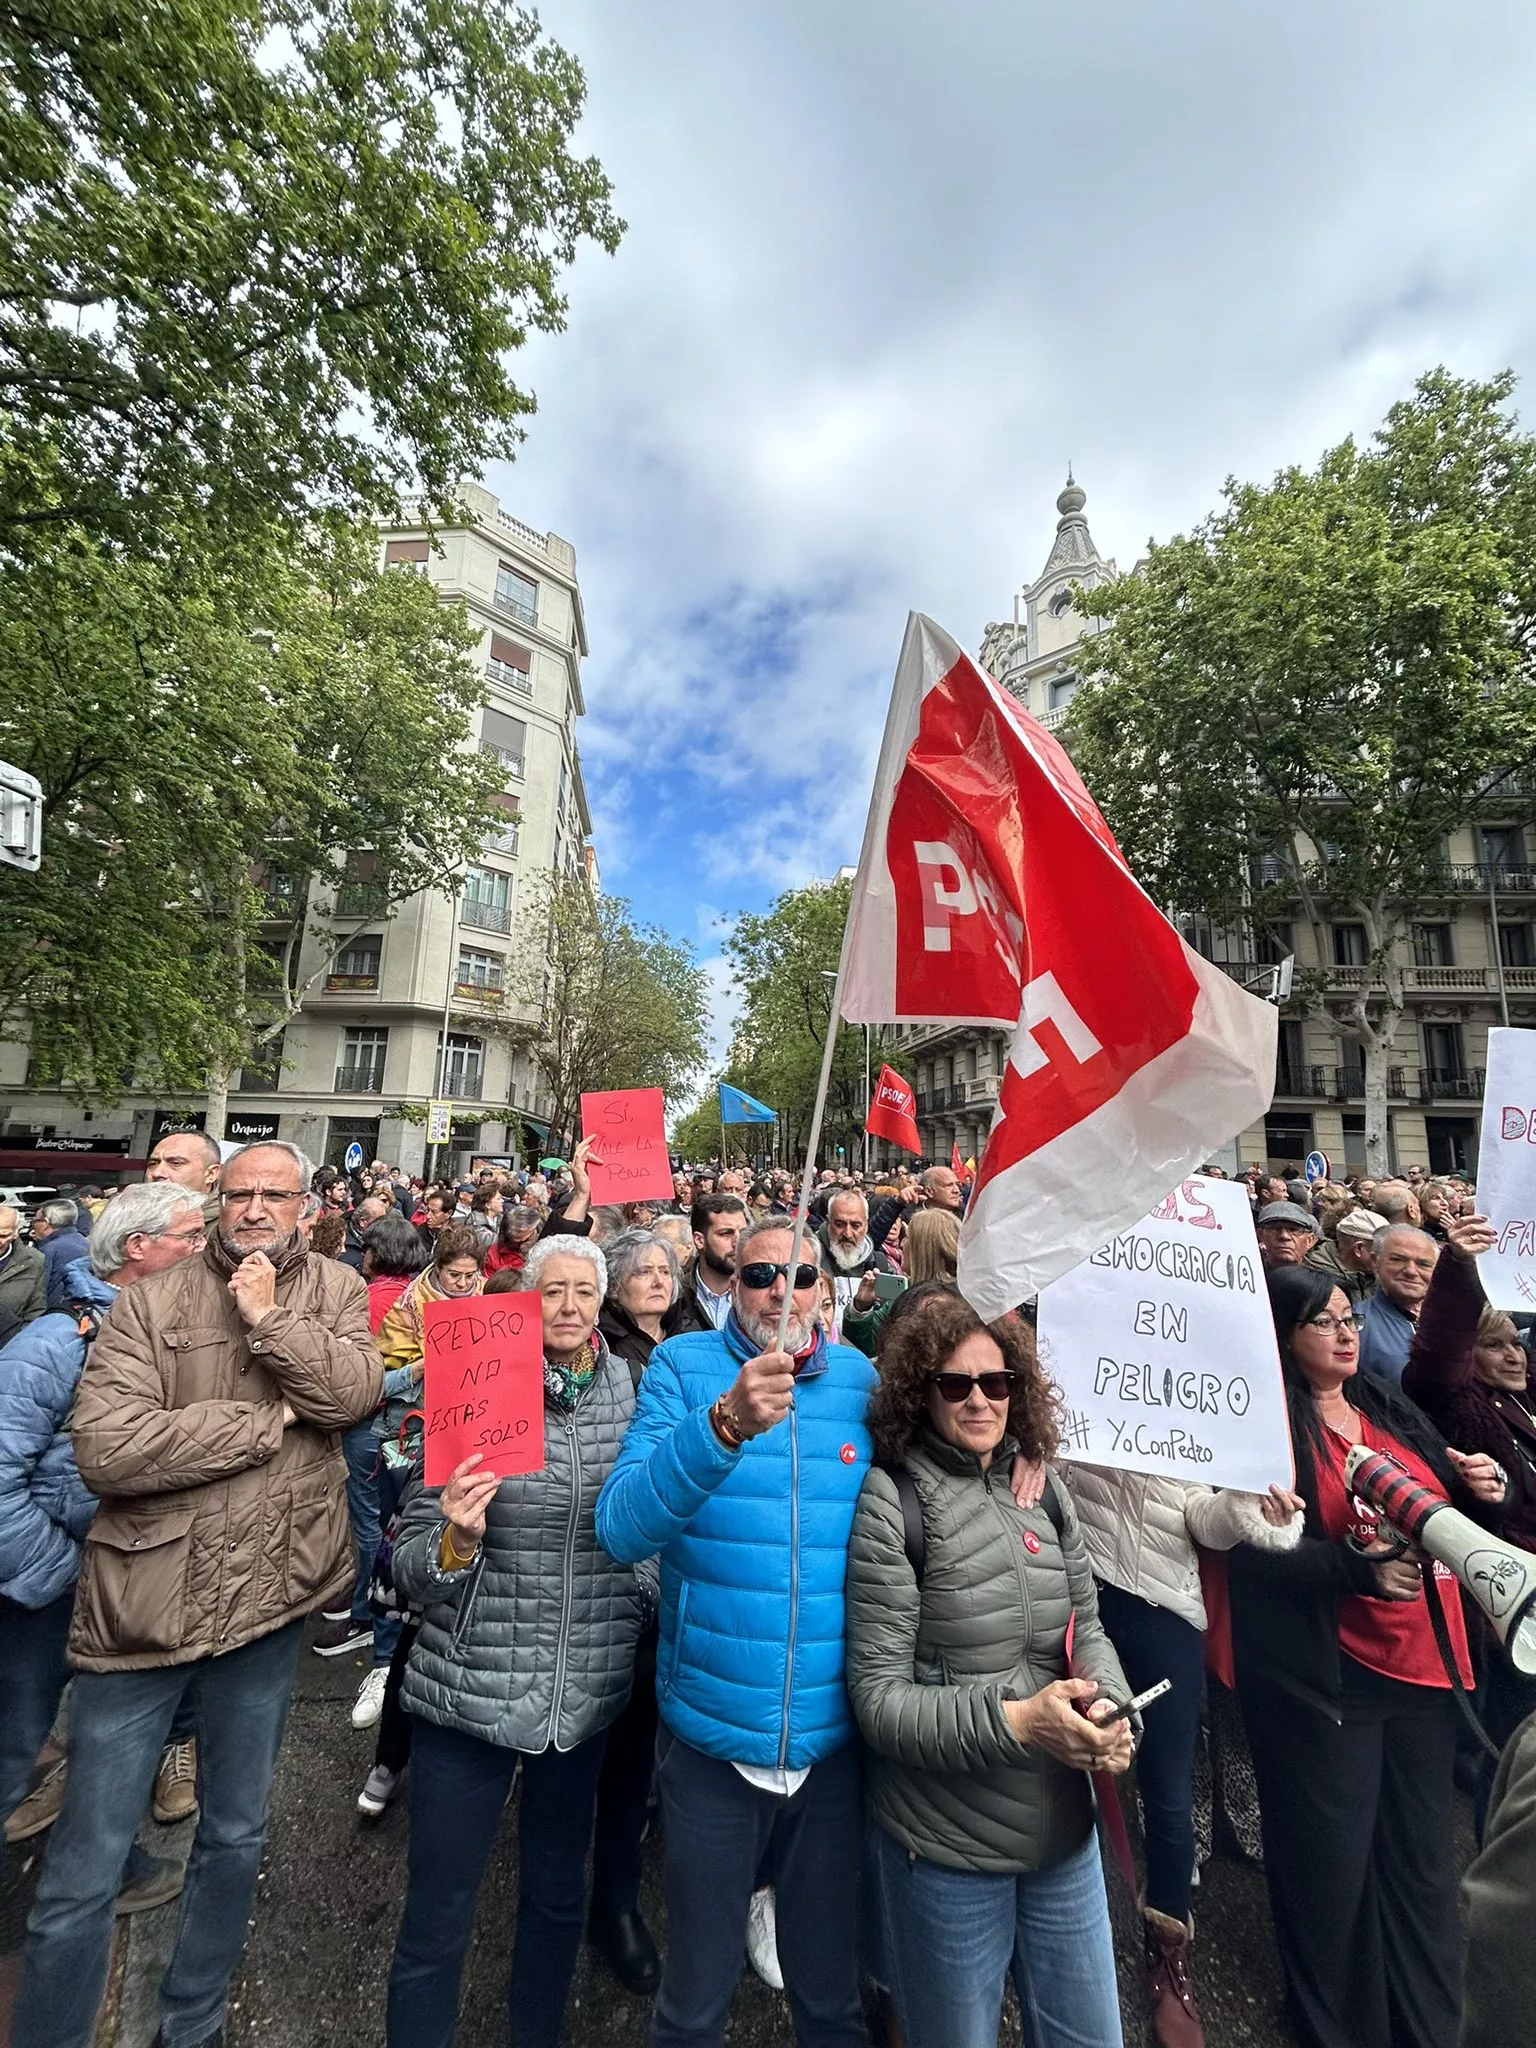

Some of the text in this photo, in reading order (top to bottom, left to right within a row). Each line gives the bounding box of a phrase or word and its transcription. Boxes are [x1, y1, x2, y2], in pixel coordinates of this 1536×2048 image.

[881, 1086, 906, 1104] PSOE
[231, 1121, 274, 1137] Urquijo
[590, 1135, 653, 1157] VALE LA
[1090, 1235, 1256, 1294] EMOCRACIA
[426, 1310, 524, 1356] PEDRO
[1134, 1300, 1188, 1343] EN
[460, 1359, 501, 1390] NO
[1094, 1357, 1250, 1416] PELIGRO
[1347, 1524, 1357, 1535] Y
